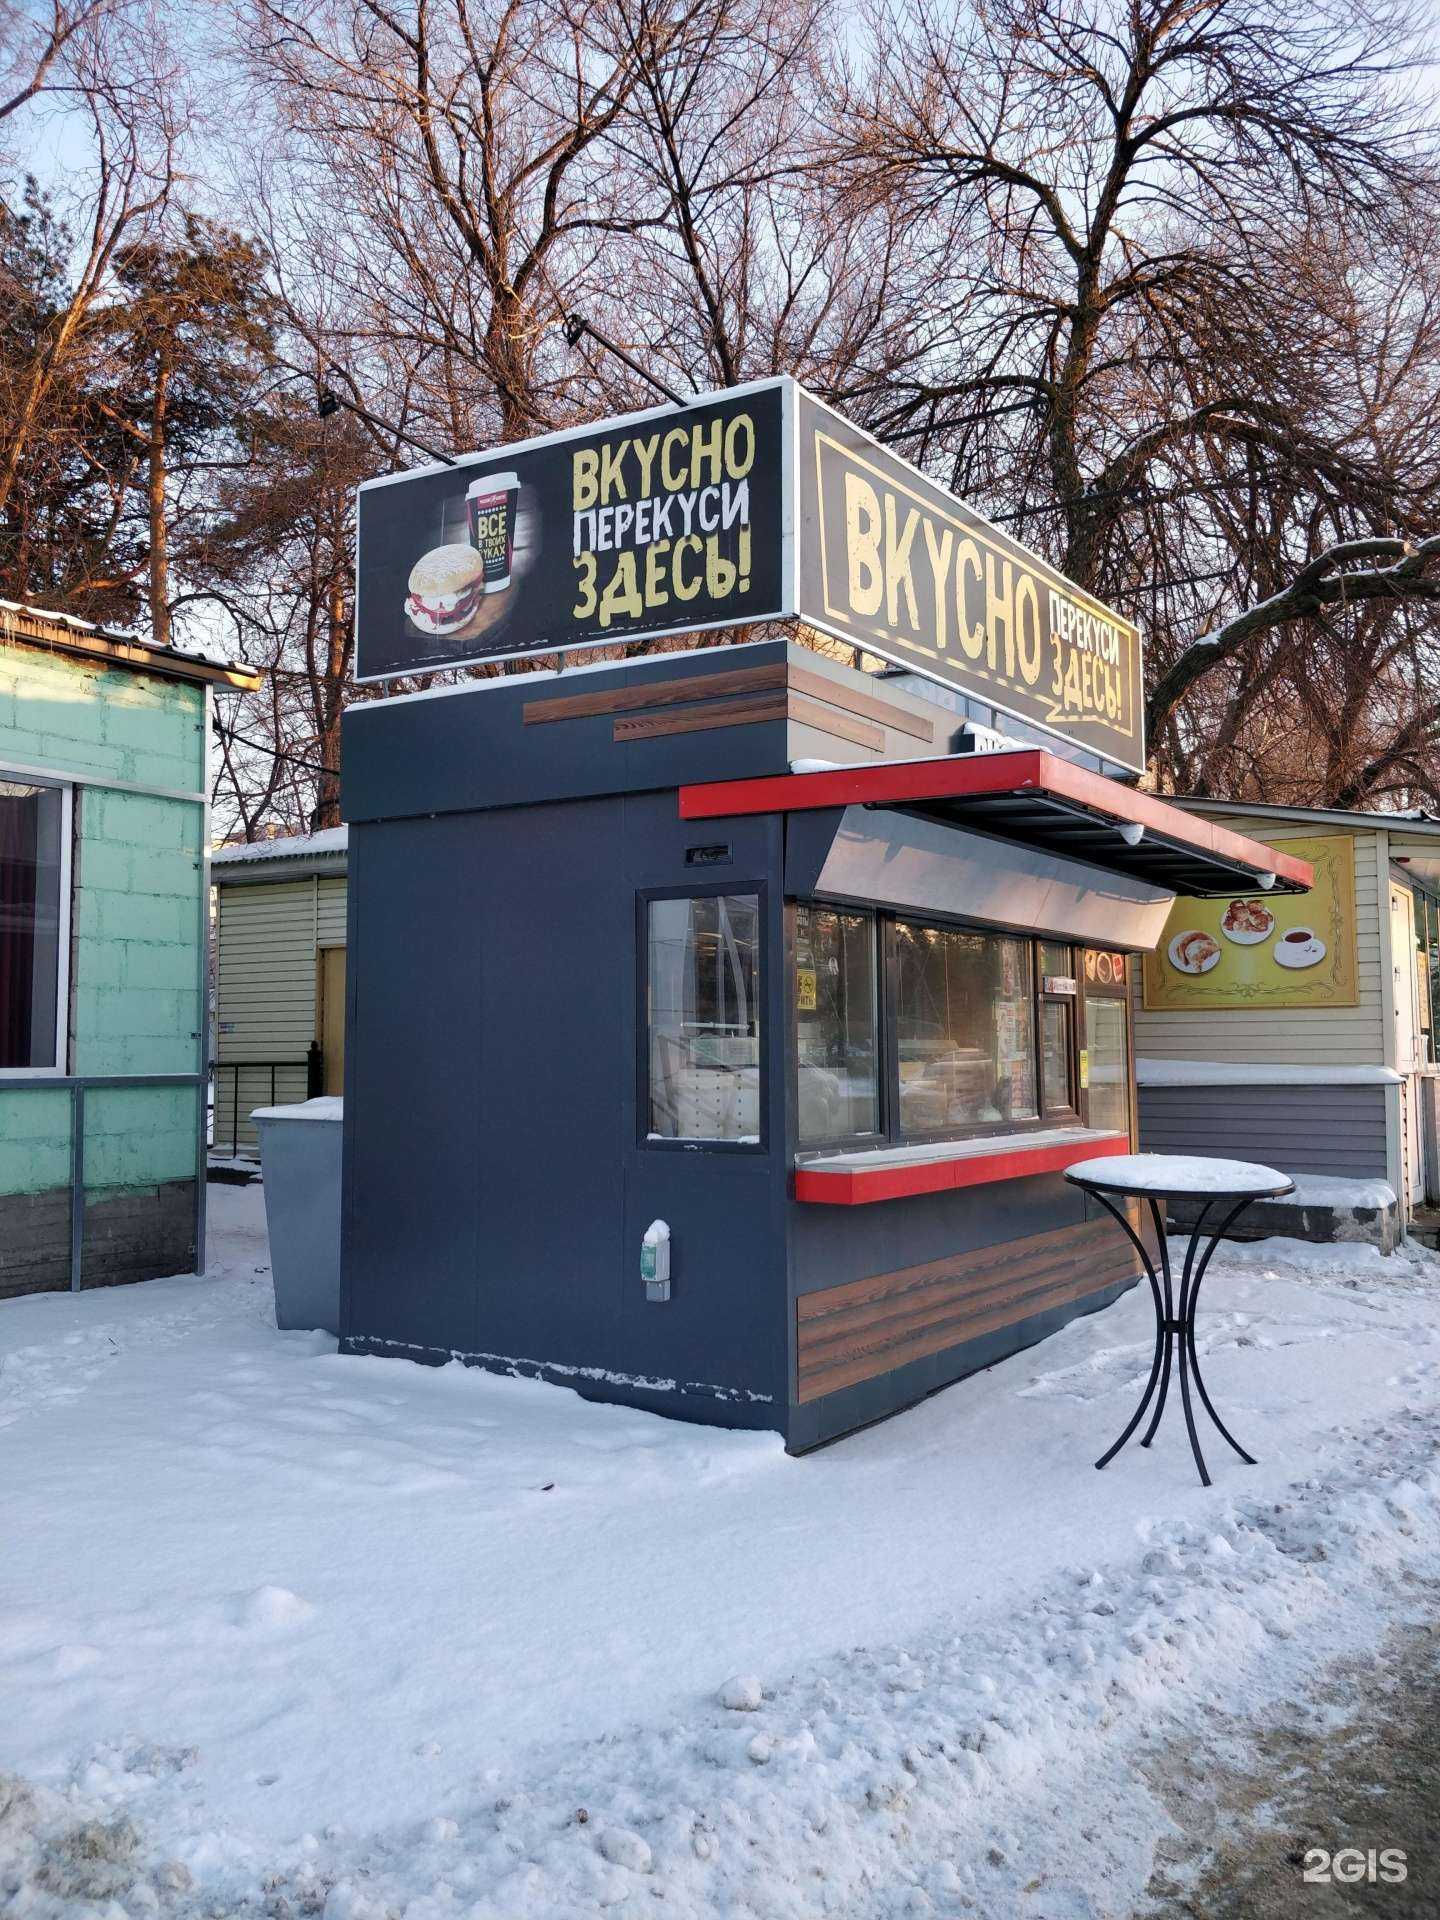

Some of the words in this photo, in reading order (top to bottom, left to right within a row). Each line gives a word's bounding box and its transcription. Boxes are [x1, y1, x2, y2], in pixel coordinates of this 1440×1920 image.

[573, 414, 755, 511] ВКУСНО
[478, 512, 507, 539] ВСЕ
[574, 479, 750, 557] ПЕРЕКУСИ
[573, 524, 751, 626] ЗДЕСЬ!
[845, 472, 1040, 685] ВКУСНО
[1049, 591, 1119, 666] ПЕРЕКУСИ
[1050, 633, 1121, 720] ЗДЕСЬ!
